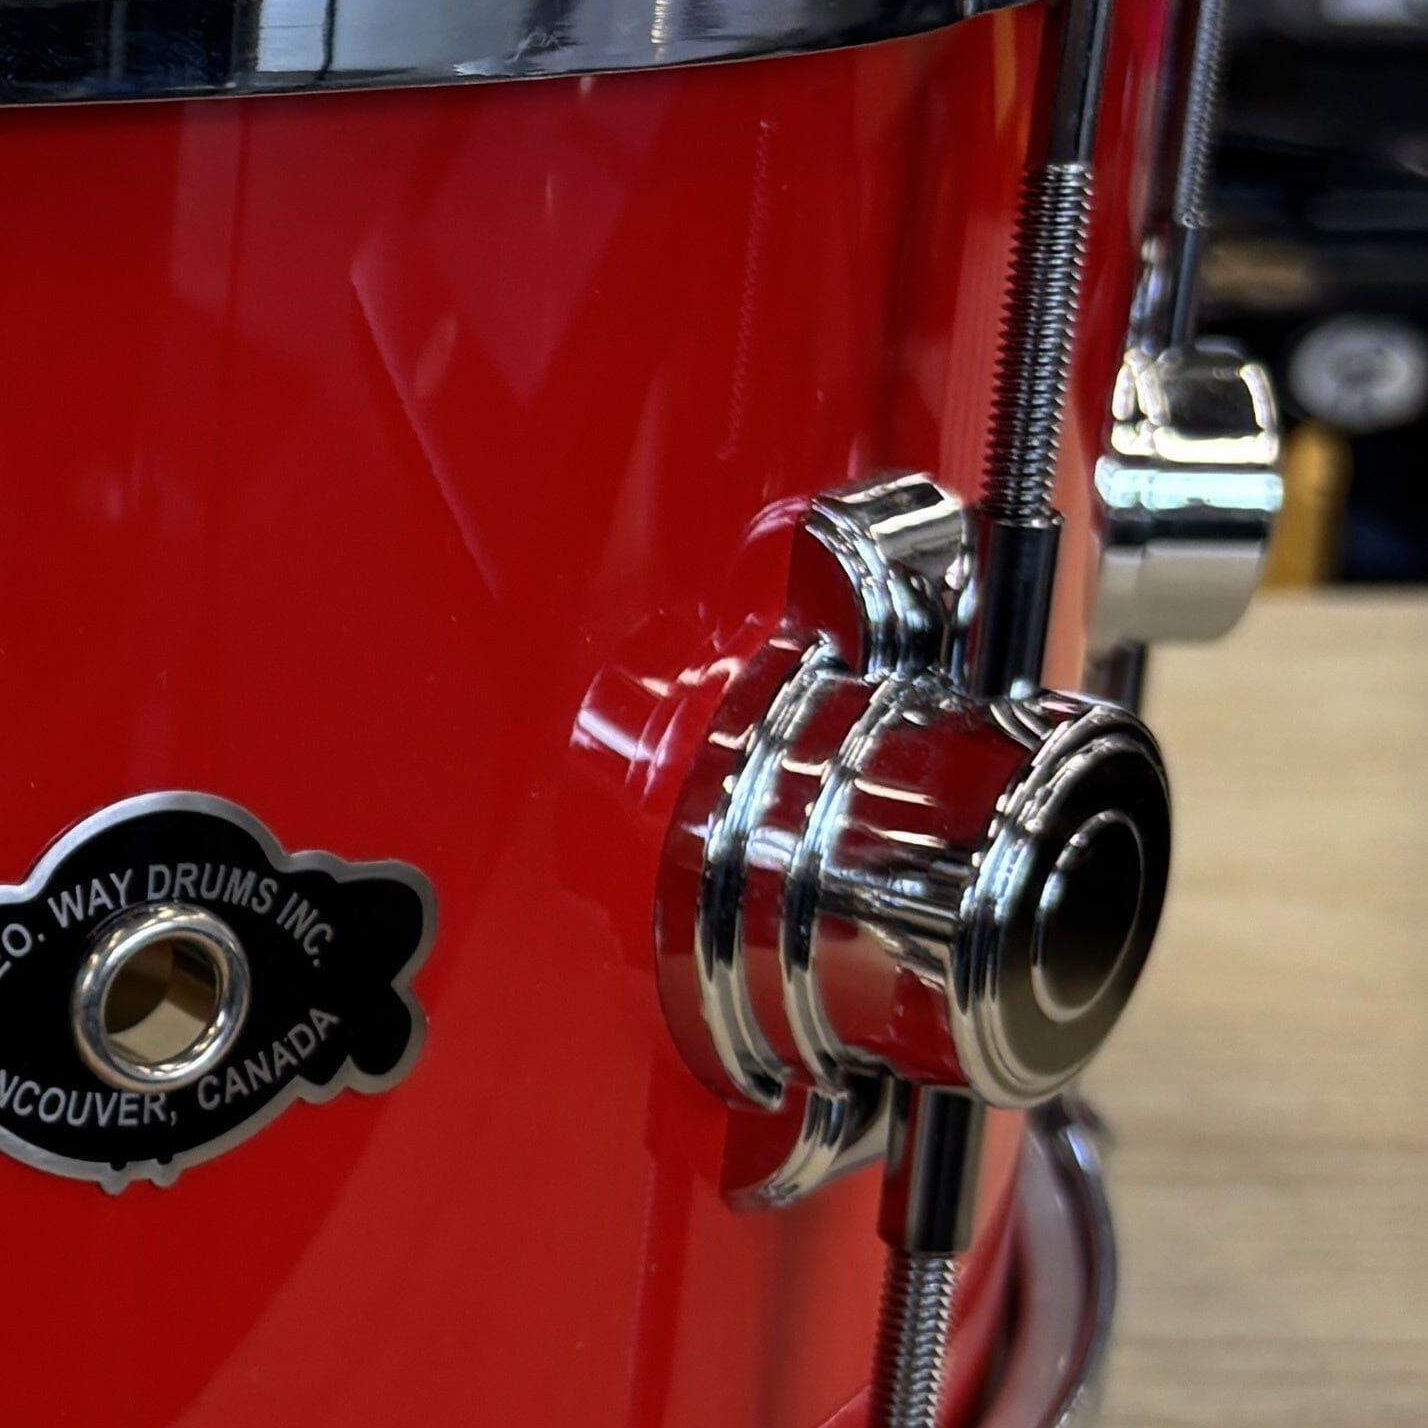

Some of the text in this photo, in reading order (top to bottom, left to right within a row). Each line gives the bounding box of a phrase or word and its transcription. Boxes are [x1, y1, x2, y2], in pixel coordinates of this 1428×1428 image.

[48, 869, 134, 929] WAY
[147, 863, 279, 915] DRUMS
[277, 895, 335, 967] INC.
[197, 1007, 342, 1112] CANADA
